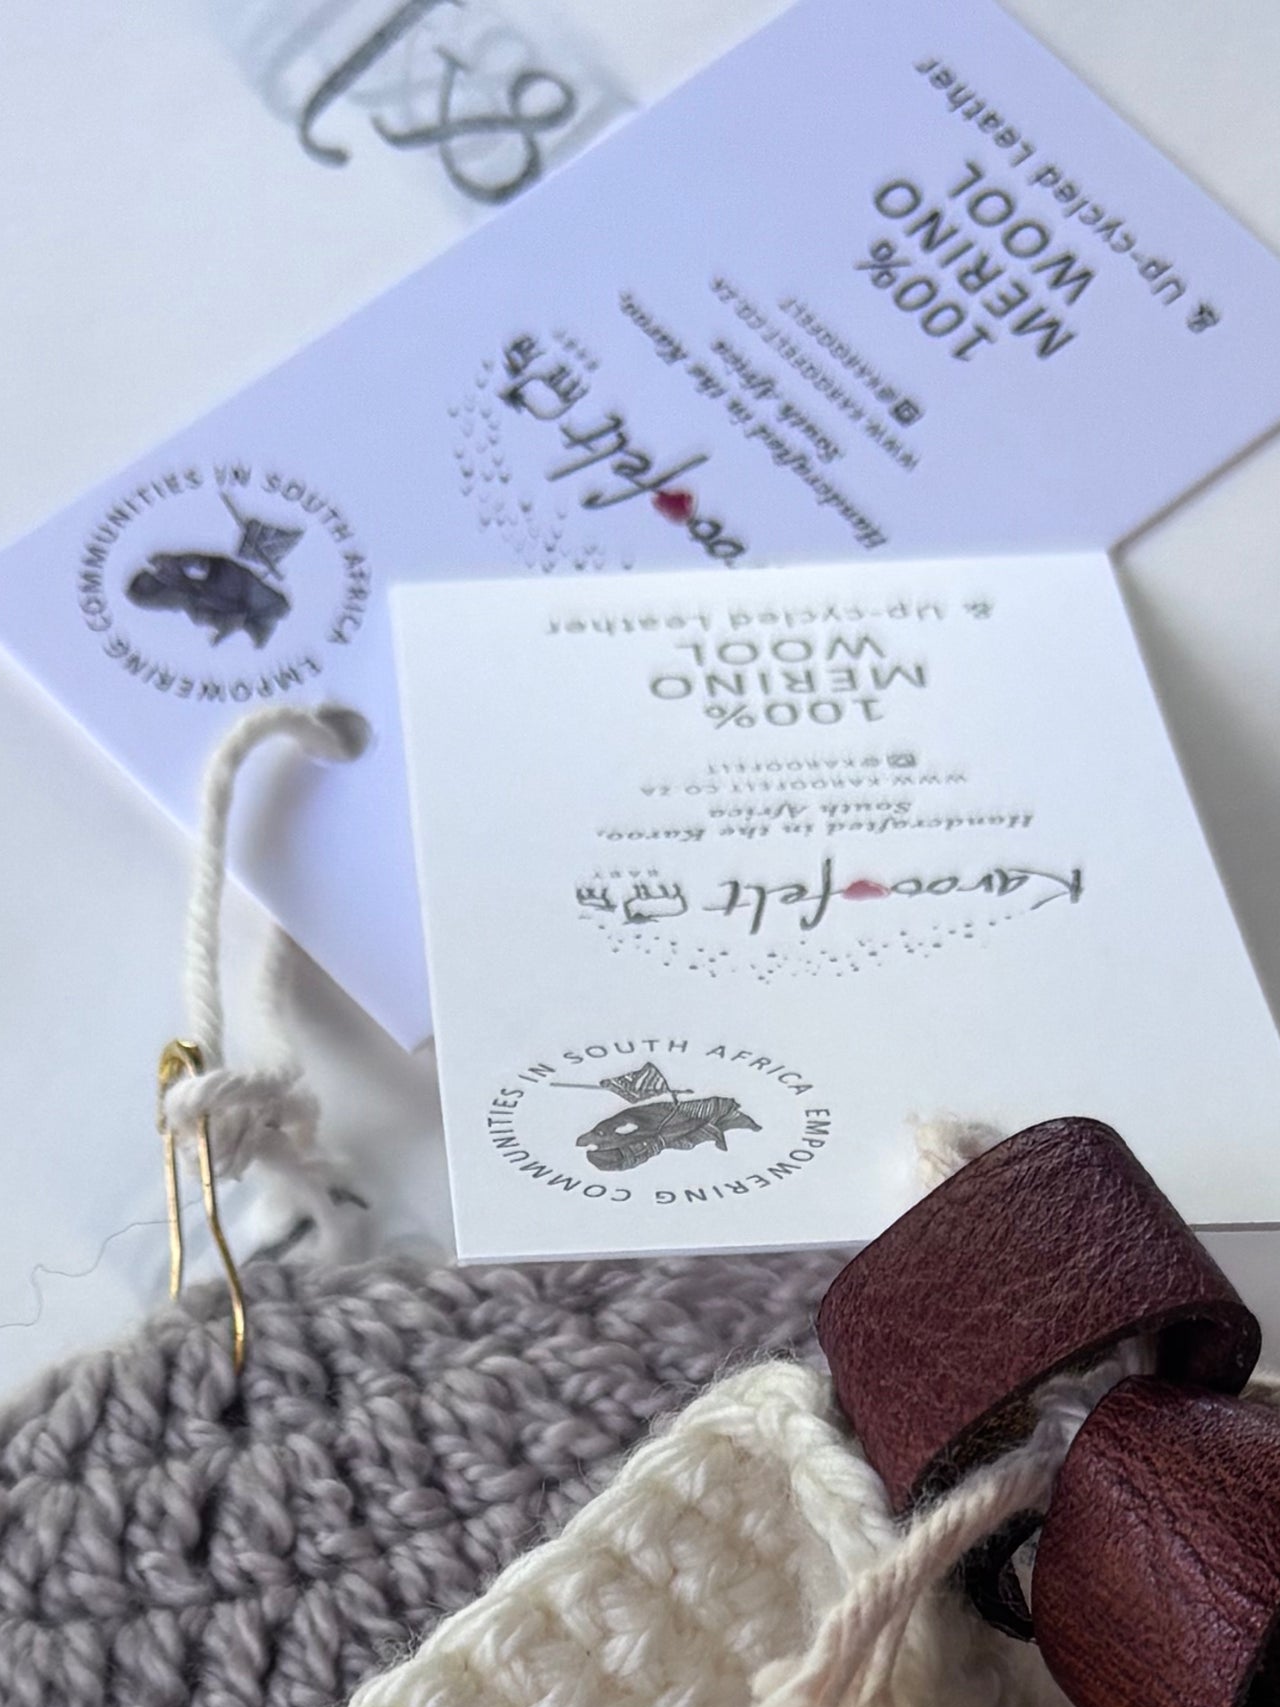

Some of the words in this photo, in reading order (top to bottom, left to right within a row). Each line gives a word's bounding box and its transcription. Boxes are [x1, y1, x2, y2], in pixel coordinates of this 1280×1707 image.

[913, 57, 1036, 168] Leather
[948, 158, 1096, 307] WOOL
[1027, 163, 1187, 306] Up-cycled
[873, 179, 1077, 360] MERINO
[854, 238, 996, 362] 100%
[1186, 301, 1221, 334] &
[687, 363, 726, 399] the
[711, 339, 780, 400] Africa
[727, 399, 753, 424] in
[777, 401, 843, 464] South
[213, 465, 251, 486] IN
[744, 423, 887, 550] Handcrafted
[261, 471, 354, 542] SOUTH
[78, 467, 203, 632] COMMUNITIES
[327, 551, 370, 644] AFRICA
[963, 601, 995, 619] &
[545, 611, 712, 636] Leather
[728, 602, 944, 631] Up-cycled
[104, 634, 322, 701] EMPOWERING
[674, 634, 887, 667] WOOL
[649, 663, 927, 701] MERINO
[703, 699, 885, 730] 100%
[709, 803, 810, 820] Africa
[818, 801, 913, 817] South
[827, 813, 1035, 836] Handcrafted
[719, 822, 770, 838] the
[781, 821, 814, 836] in
[563, 1038, 689, 1065] SOUTH
[518, 1062, 557, 1084] IN
[705, 1044, 814, 1097] AFRICA
[487, 1086, 632, 1203] COMMUNITIES
[654, 1107, 832, 1205] EMPOWERING
